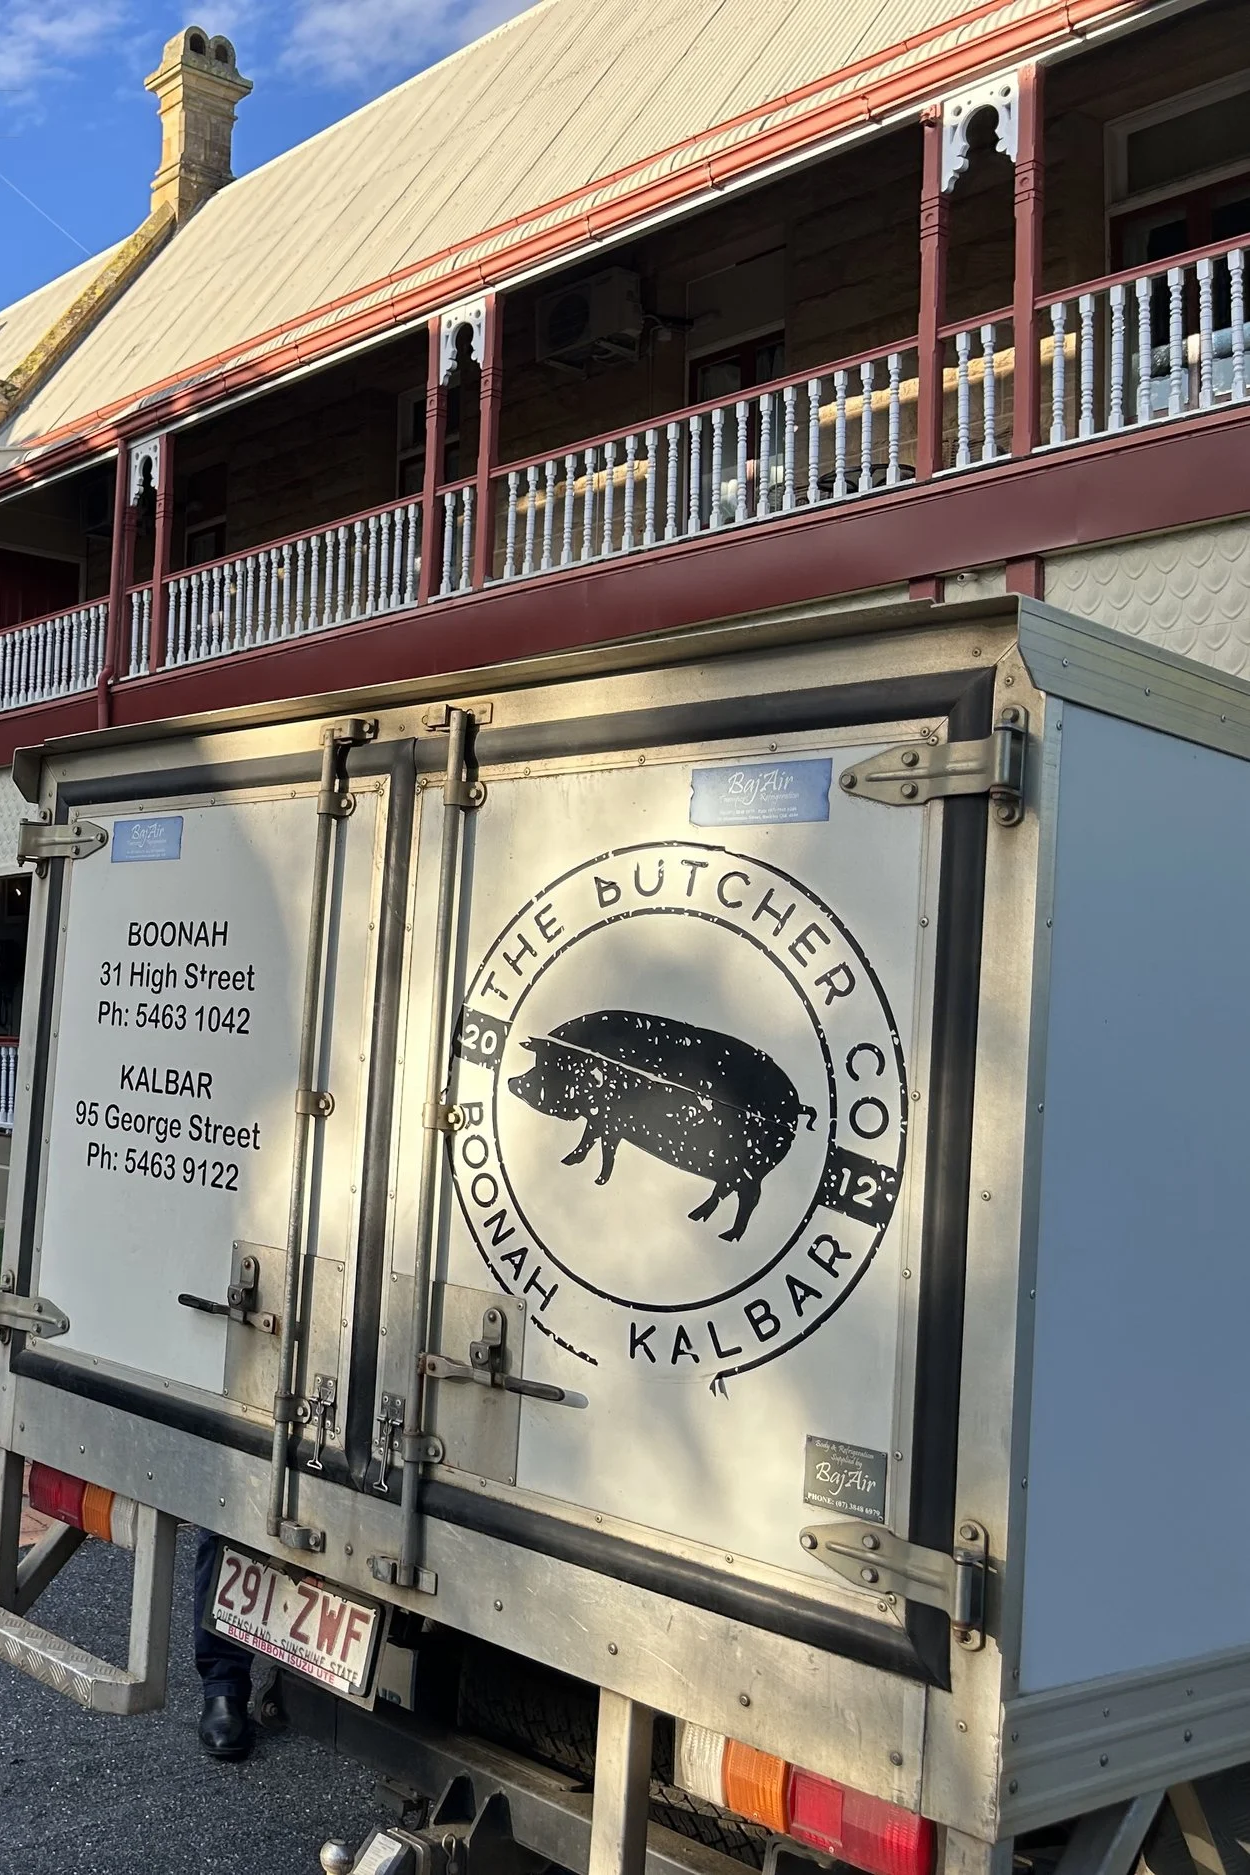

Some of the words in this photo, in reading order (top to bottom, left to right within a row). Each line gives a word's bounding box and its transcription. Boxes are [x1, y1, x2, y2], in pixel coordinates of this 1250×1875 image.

[728, 769, 794, 806] BajAir
[128, 920, 229, 948] BOONAH
[100, 961, 121, 986] 31
[130, 962, 177, 994] High
[184, 963, 255, 992] Street
[98, 1001, 129, 1028] Ph:
[135, 1003, 187, 1031] 5463
[194, 1007, 250, 1035] 1042
[481, 907, 564, 1003] THE
[594, 859, 856, 1006] BUTCHER
[845, 1042, 889, 1140] CO
[461, 1024, 497, 1055] 20
[120, 1064, 213, 1100] KALBAR
[76, 1101, 99, 1127] 95
[104, 1105, 181, 1144] George
[189, 1114, 261, 1151] Street
[87, 1142, 118, 1172] Ph:
[124, 1148, 176, 1181] 5463
[183, 1157, 240, 1192] 9122
[839, 1167, 877, 1208] 12
[629, 1229, 853, 1365] KALBAR
[816, 1461, 876, 1495] BajAir
[807, 1492, 834, 1505] PHONE:
[835, 1500, 848, 1509] (07)
[217, 1557, 277, 1625] 291
[290, 1585, 371, 1663] ZWF
[216, 1609, 271, 1642] QUEENSLAND
[281, 1638, 326, 1666] SUNSHINE
[330, 1662, 359, 1682] STATE
[228, 1624, 250, 1643] BLUE
[252, 1638, 285, 1660] RIBBON
[287, 1655, 314, 1674] ISUZU
[316, 1668, 335, 1684] UTE
